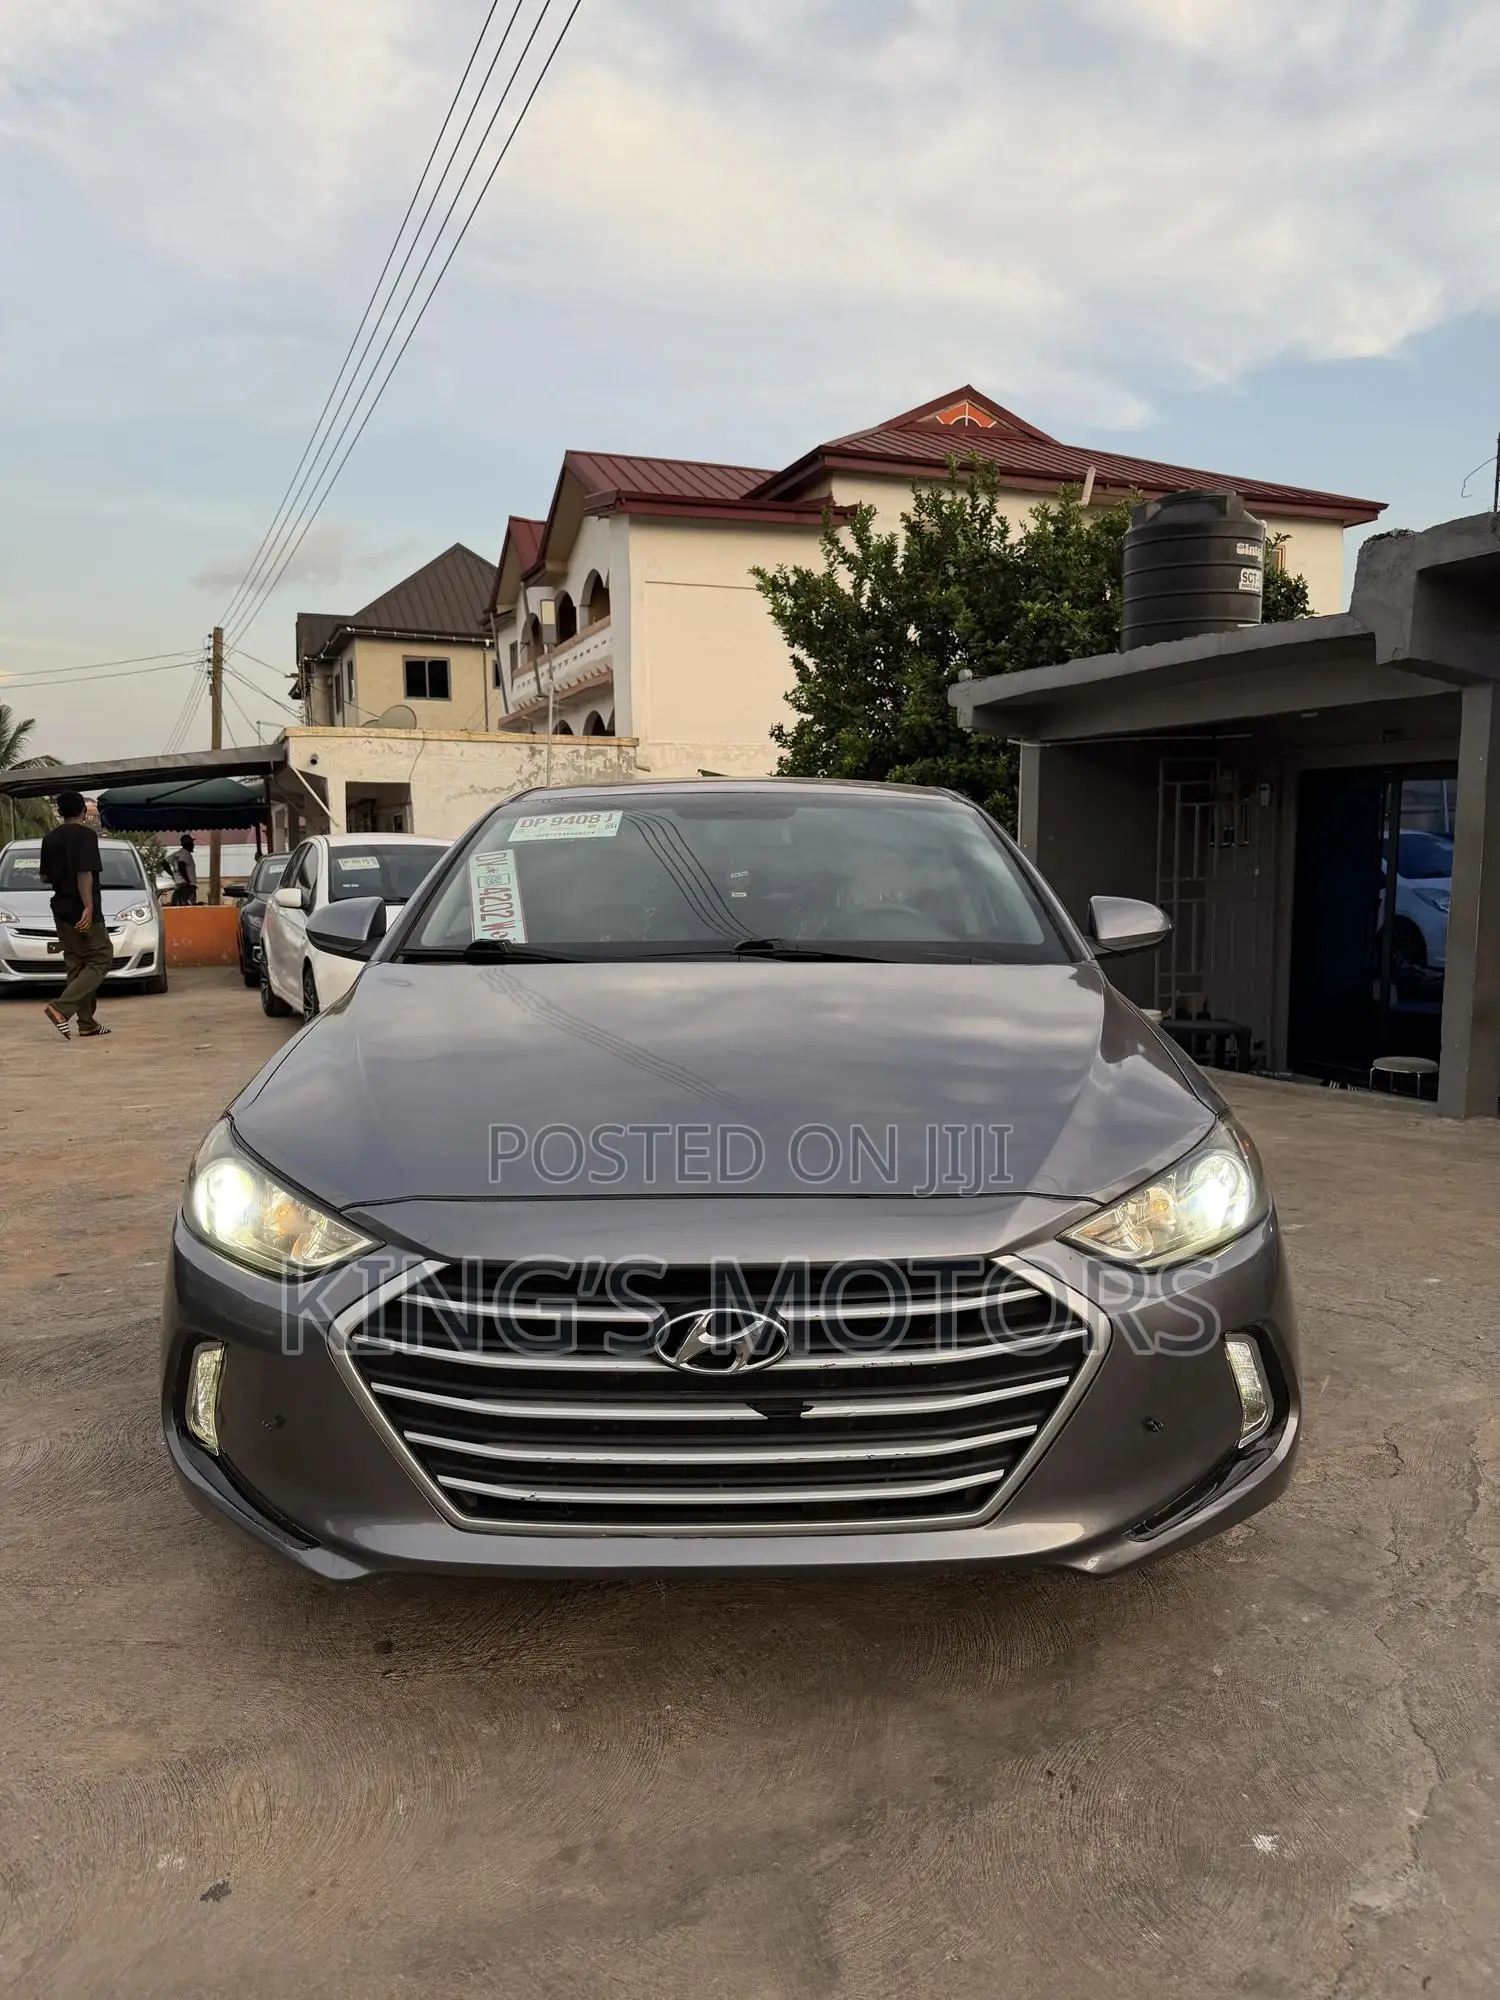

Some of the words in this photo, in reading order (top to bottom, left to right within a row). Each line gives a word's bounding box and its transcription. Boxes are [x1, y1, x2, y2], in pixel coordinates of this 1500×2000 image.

[520, 818, 547, 828] DP
[550, 813, 602, 826] 9408
[479, 887, 515, 922] 4202
